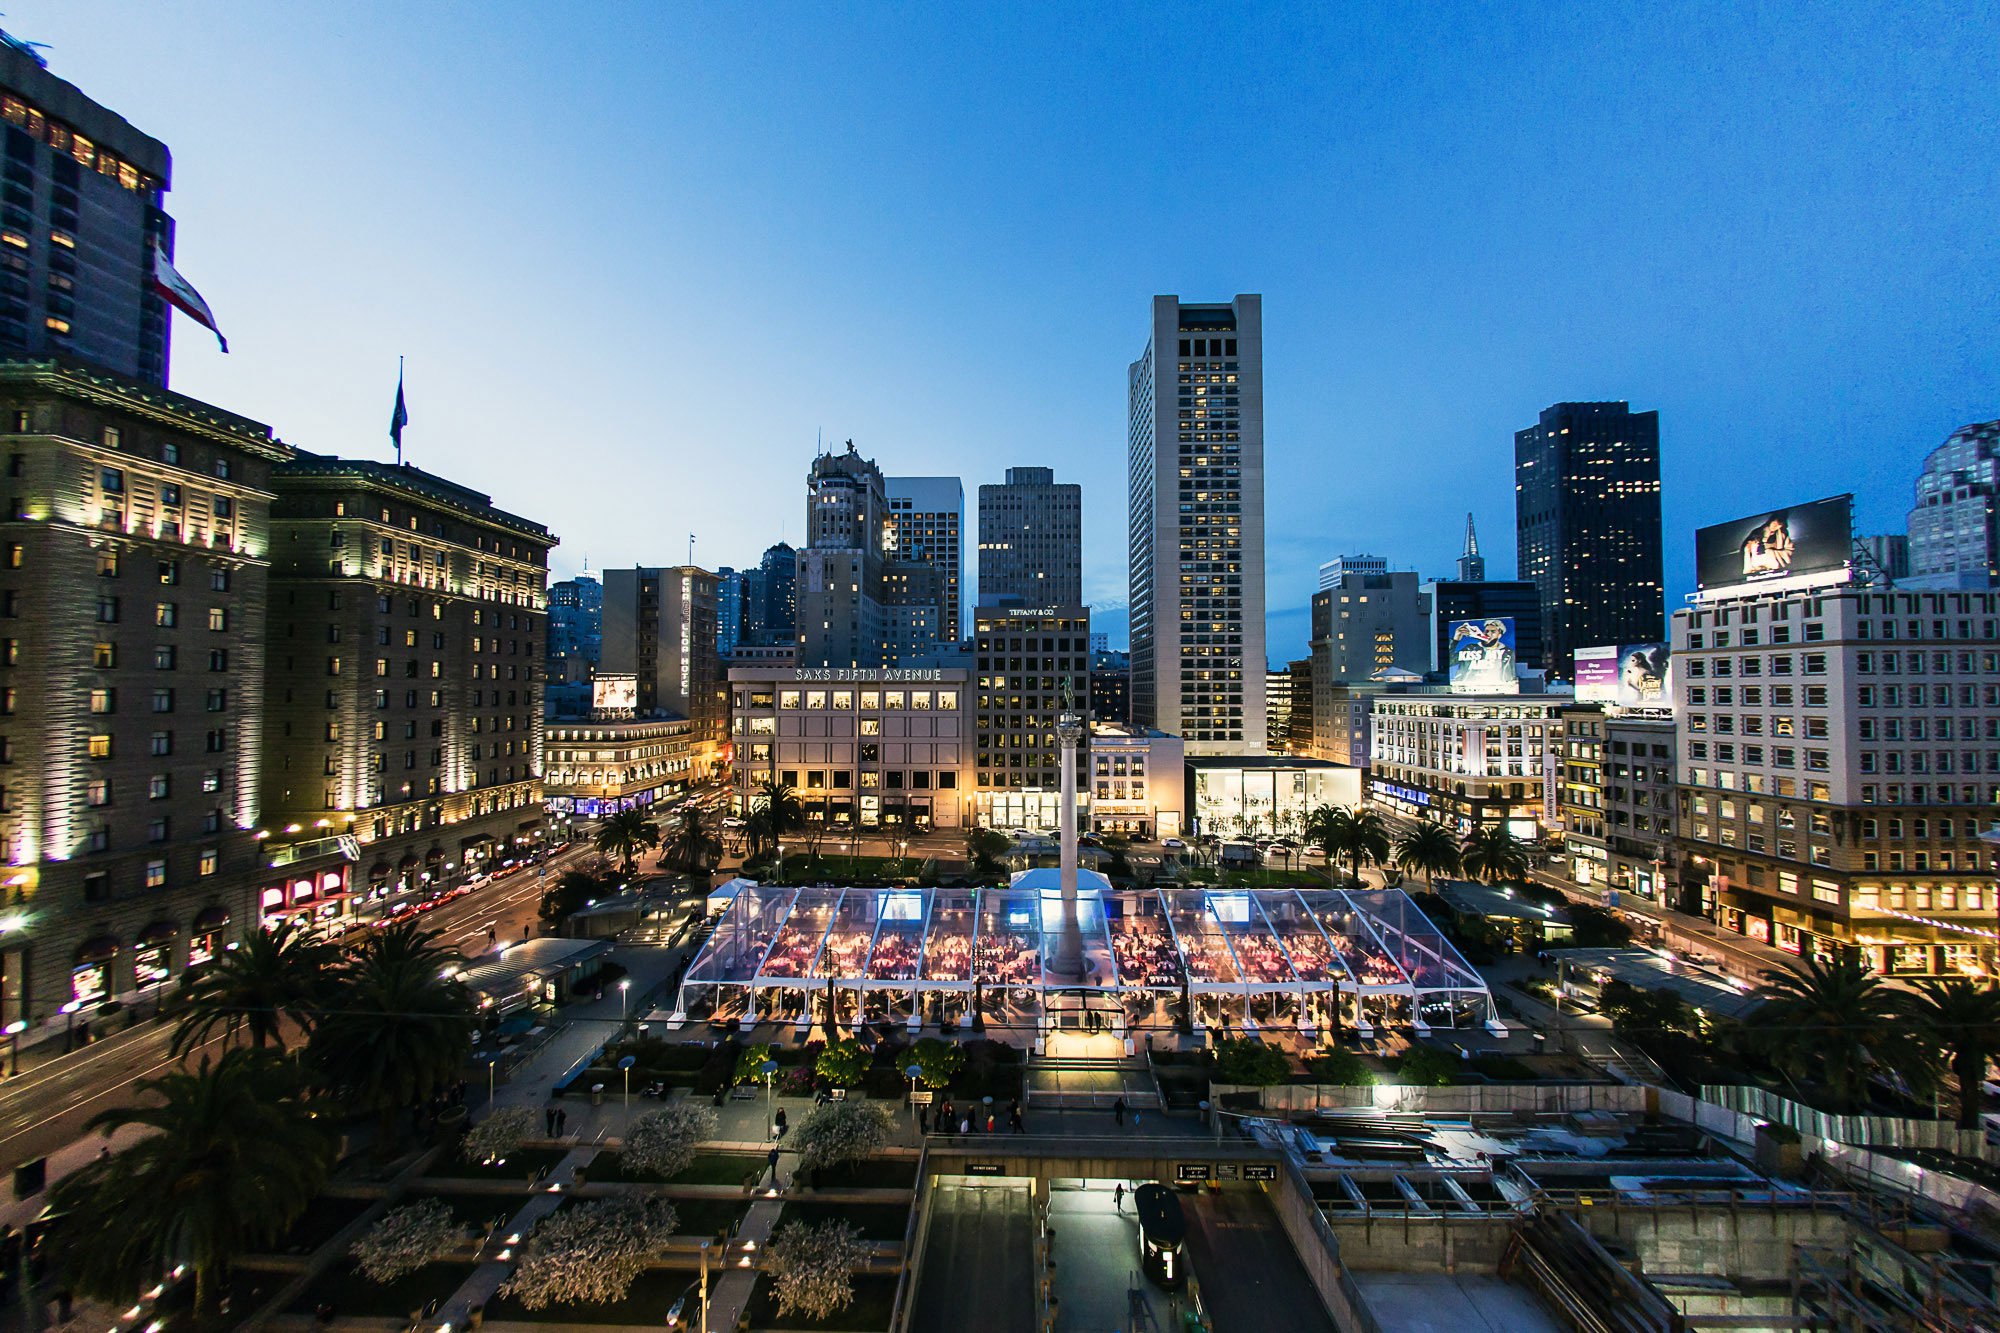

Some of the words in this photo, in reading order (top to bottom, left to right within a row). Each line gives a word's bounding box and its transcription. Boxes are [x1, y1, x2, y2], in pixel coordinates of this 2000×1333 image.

[681, 577, 690, 653] CHANCELLOR
[1458, 650, 1482, 661] KISS
[1485, 649, 1505, 660] MY
[681, 658, 689, 695] HOTEL
[795, 669, 831, 681] SAKS
[837, 669, 877, 681] FIFTH
[884, 669, 941, 681] AVENUE
[1545, 767, 1553, 793] JOHNSTON
